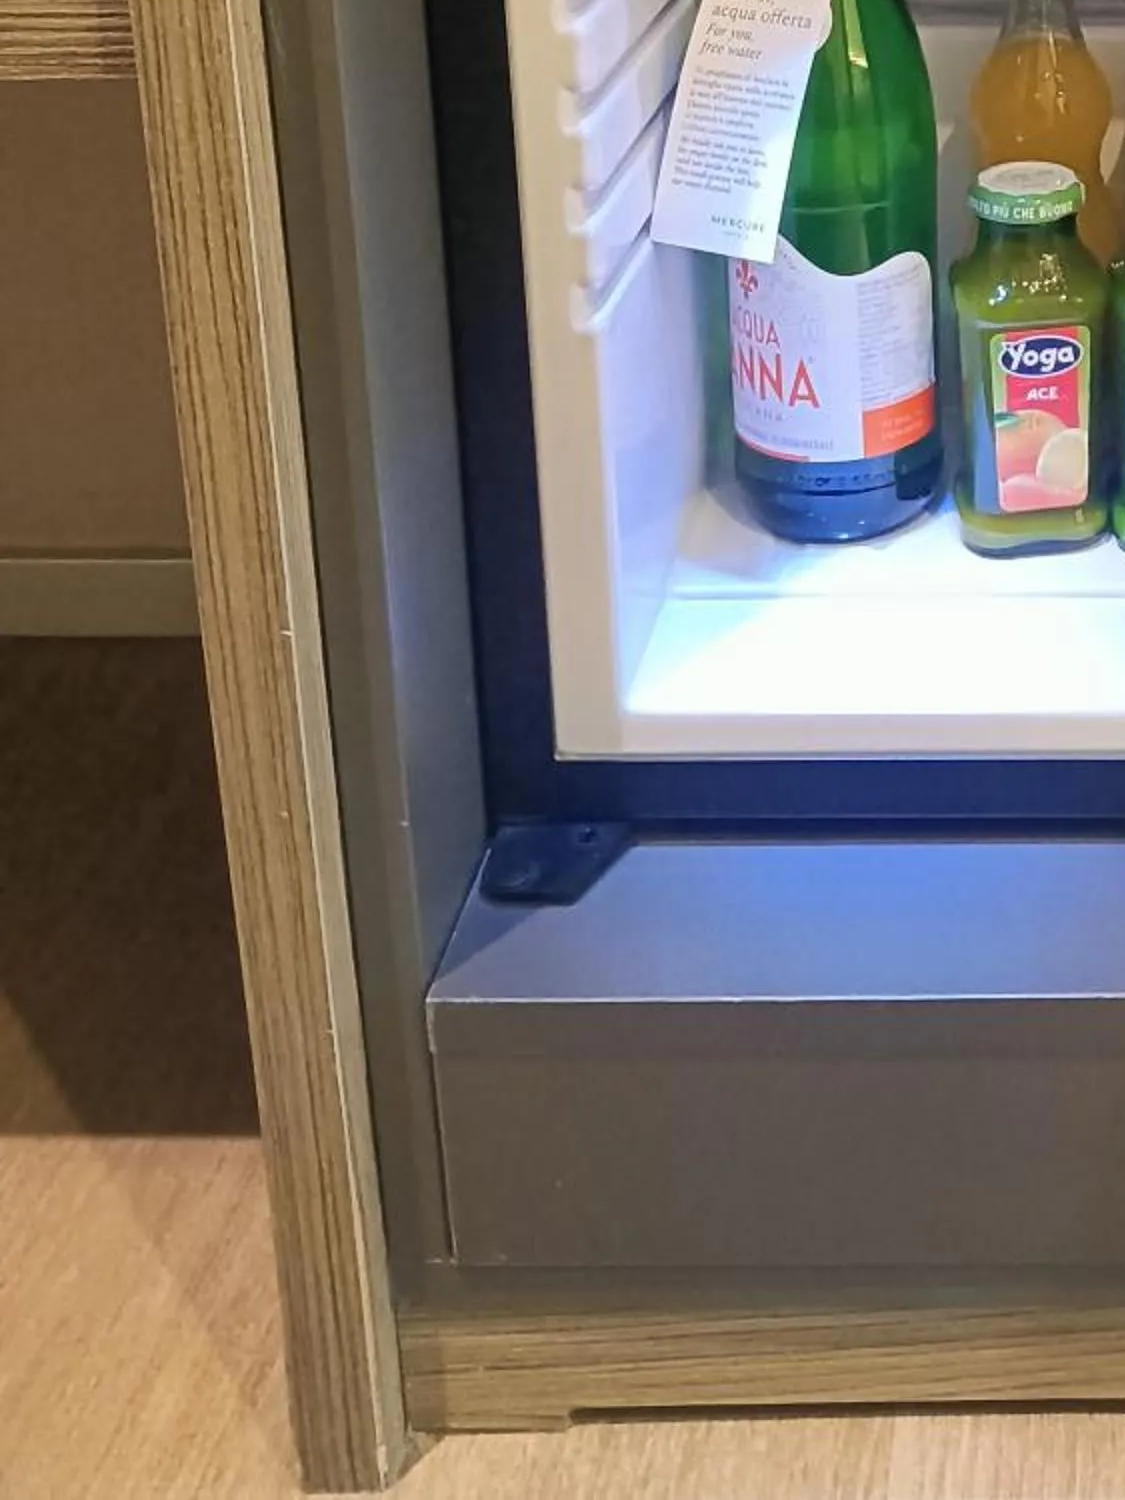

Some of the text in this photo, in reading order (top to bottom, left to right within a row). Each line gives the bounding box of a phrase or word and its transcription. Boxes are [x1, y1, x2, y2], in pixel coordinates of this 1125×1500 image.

[712, 5, 812, 29] acqua offerta
[1002, 341, 1075, 373] Yoga
[1026, 386, 1059, 401] ACE
